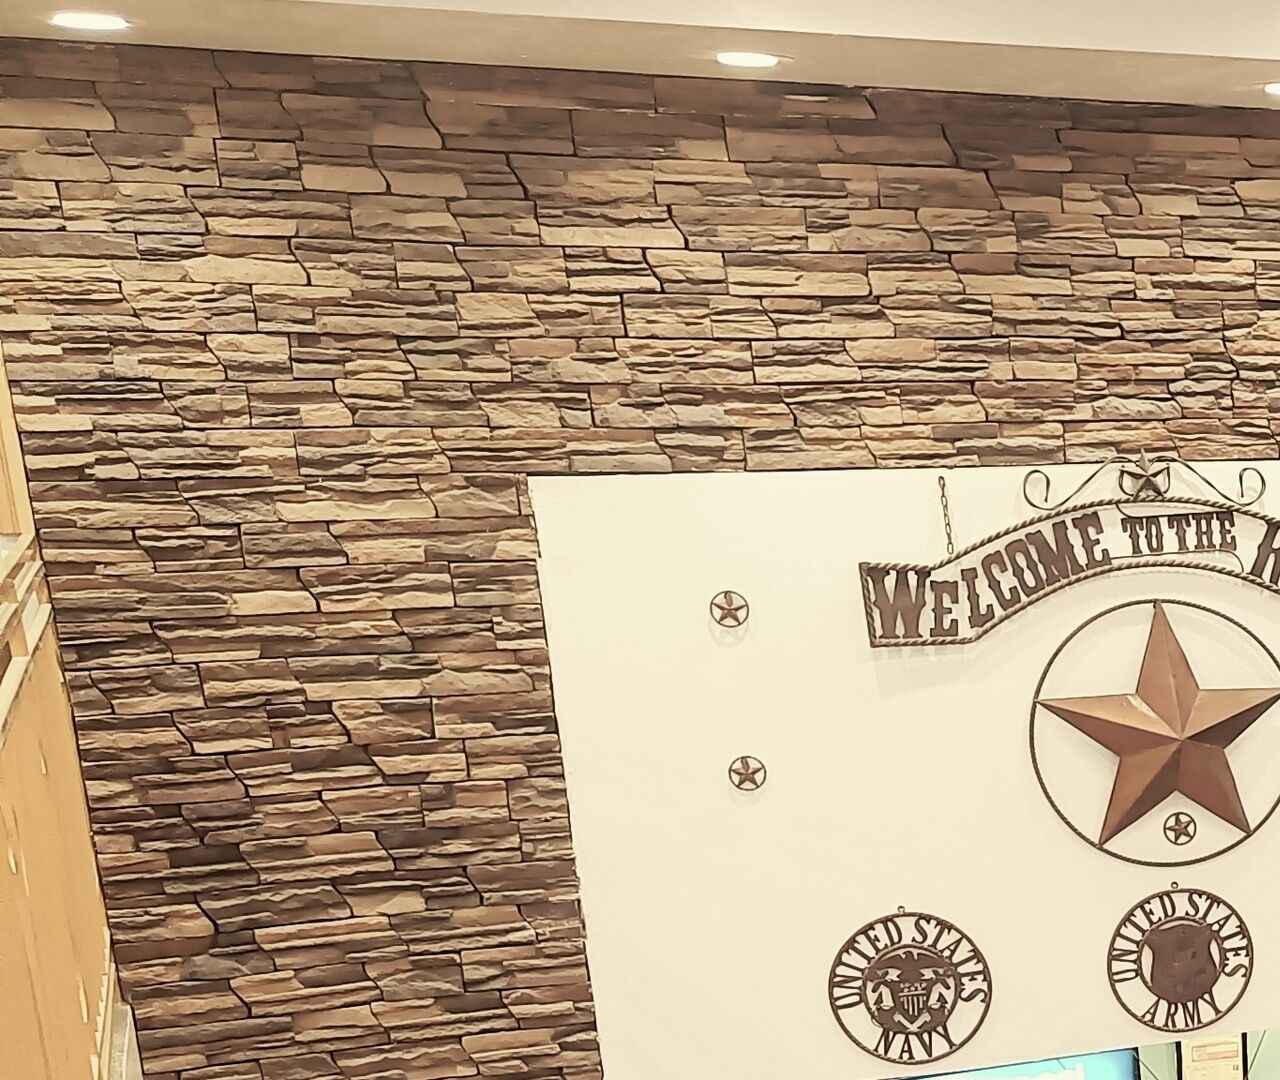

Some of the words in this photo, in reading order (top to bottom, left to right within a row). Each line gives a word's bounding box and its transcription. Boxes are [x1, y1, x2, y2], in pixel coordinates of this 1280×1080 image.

[867, 511, 1112, 640] WELCOME
[1120, 516, 1165, 557] TO
[1168, 511, 1238, 552] THE
[832, 917, 903, 1010] UNITED
[911, 916, 988, 1004] STATES
[1110, 892, 1177, 983] UNITED
[1185, 891, 1251, 978] STATES
[872, 1022, 959, 1061] NAVY
[1138, 991, 1224, 1029] ARMY
